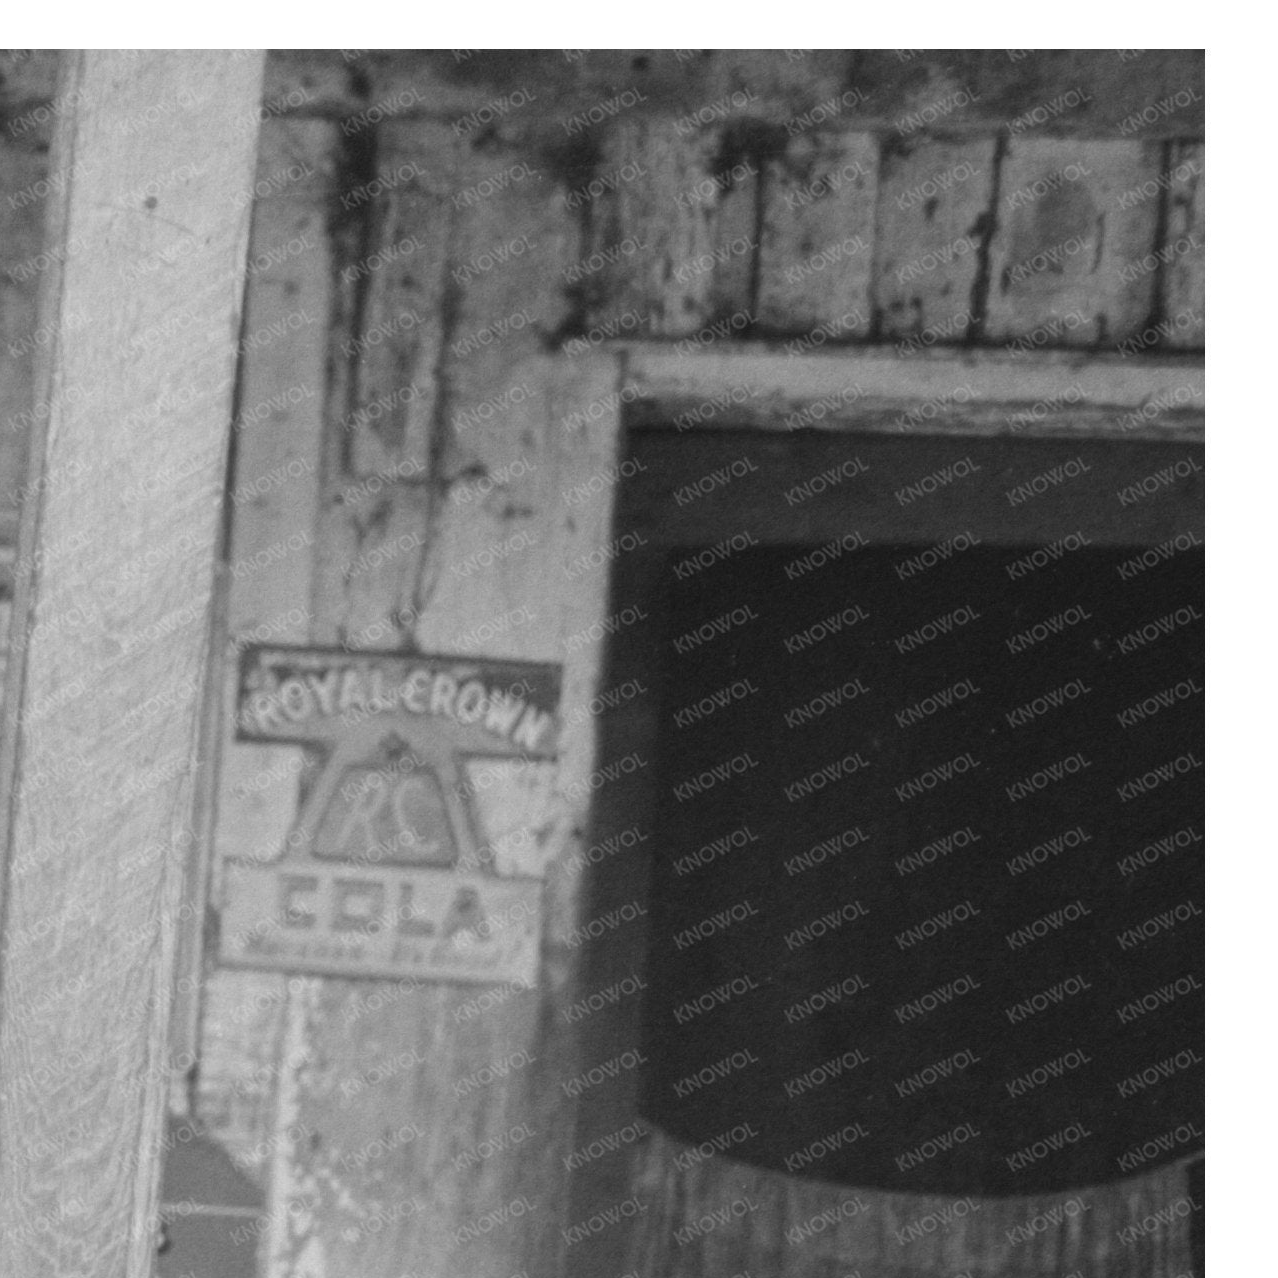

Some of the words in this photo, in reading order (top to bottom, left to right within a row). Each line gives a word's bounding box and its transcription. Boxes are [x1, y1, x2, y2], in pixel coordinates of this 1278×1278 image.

[251, 669, 393, 733] ROYAL
[402, 669, 552, 749] CROWN
[276, 873, 492, 943] COLA
